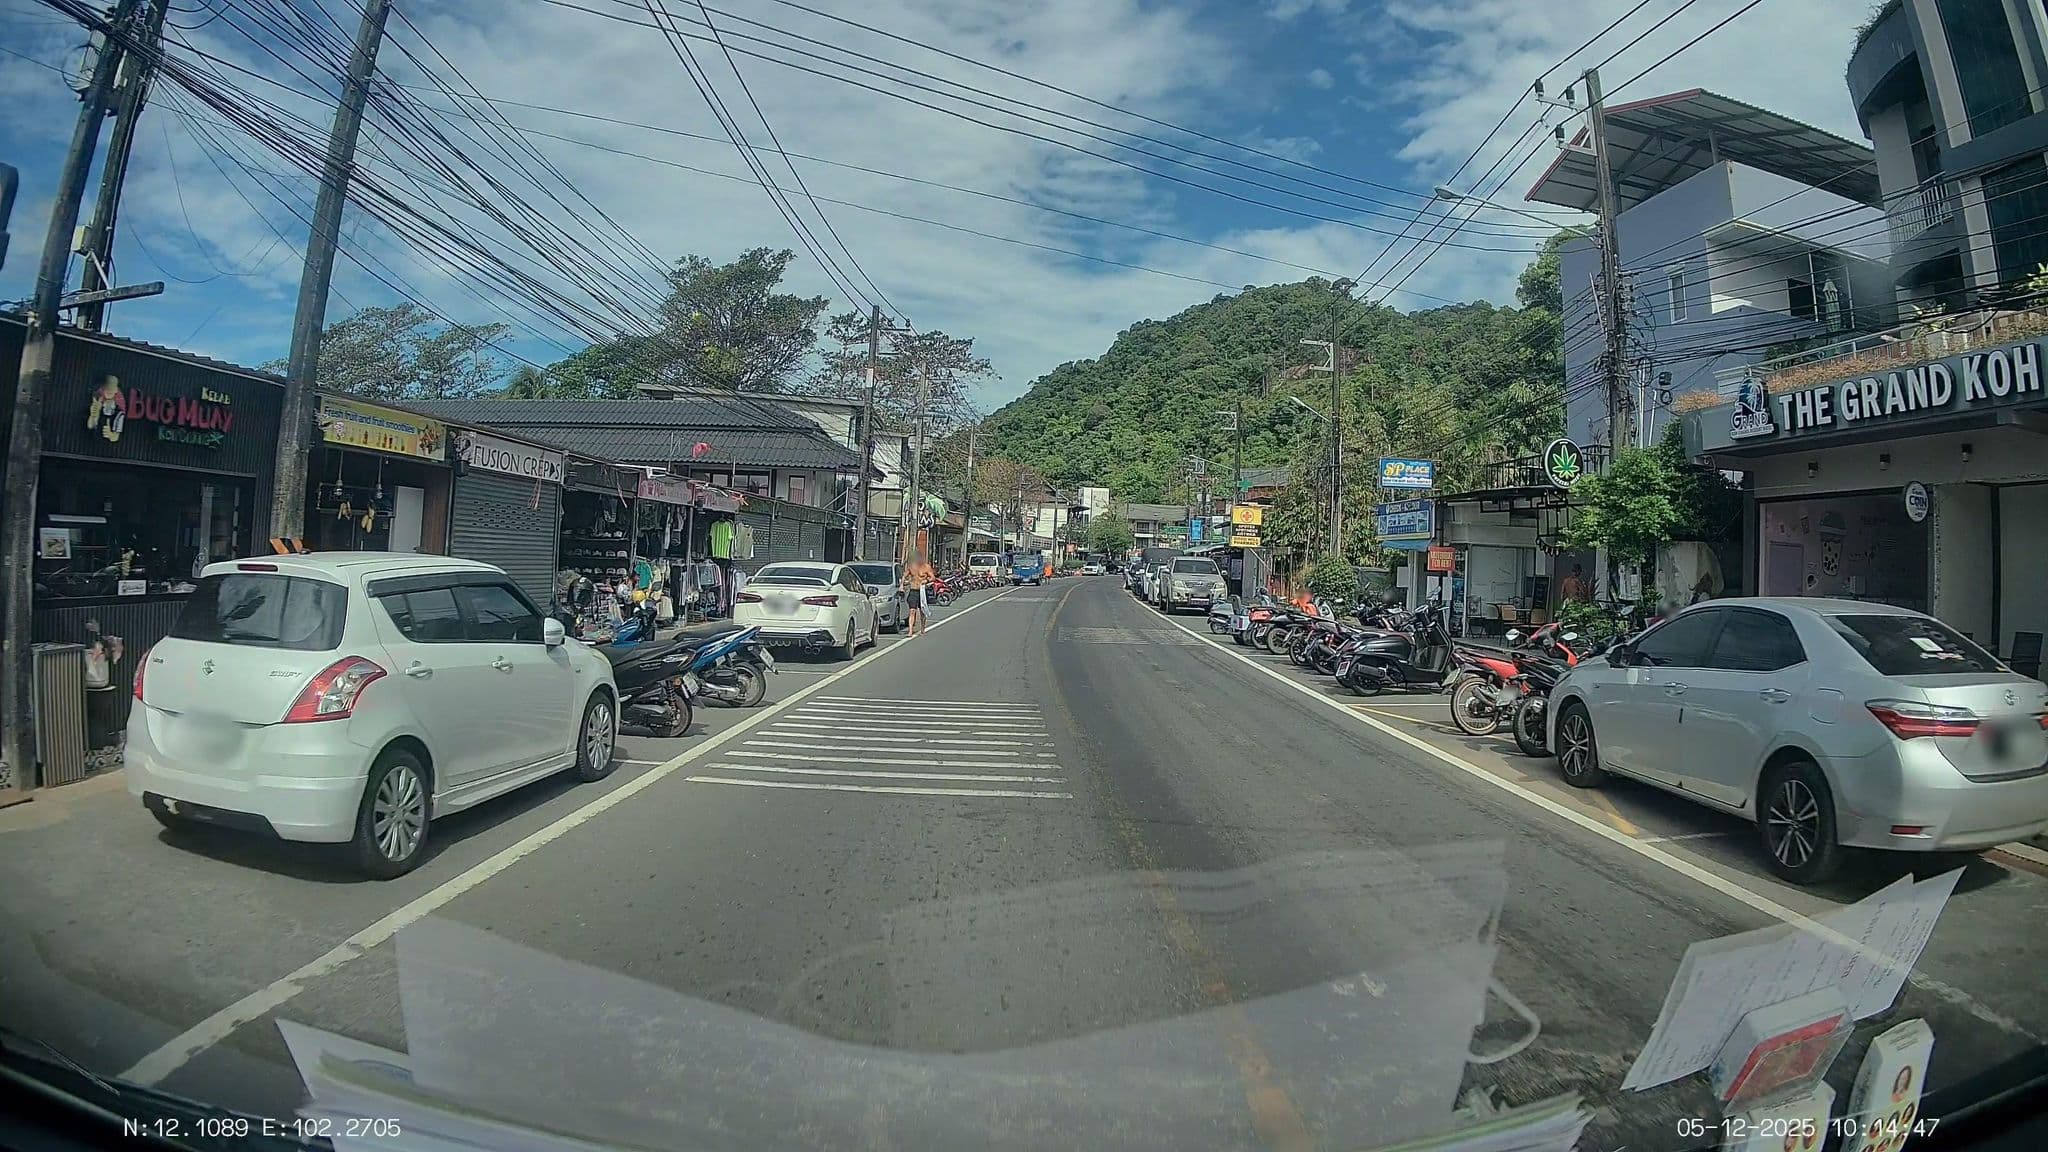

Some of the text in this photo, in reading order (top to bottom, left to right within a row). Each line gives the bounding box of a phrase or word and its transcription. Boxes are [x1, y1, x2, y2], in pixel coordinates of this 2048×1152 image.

[1779, 344, 2040, 431] THE GRAND KOH
[473, 445, 560, 480] FUSION CREPS
